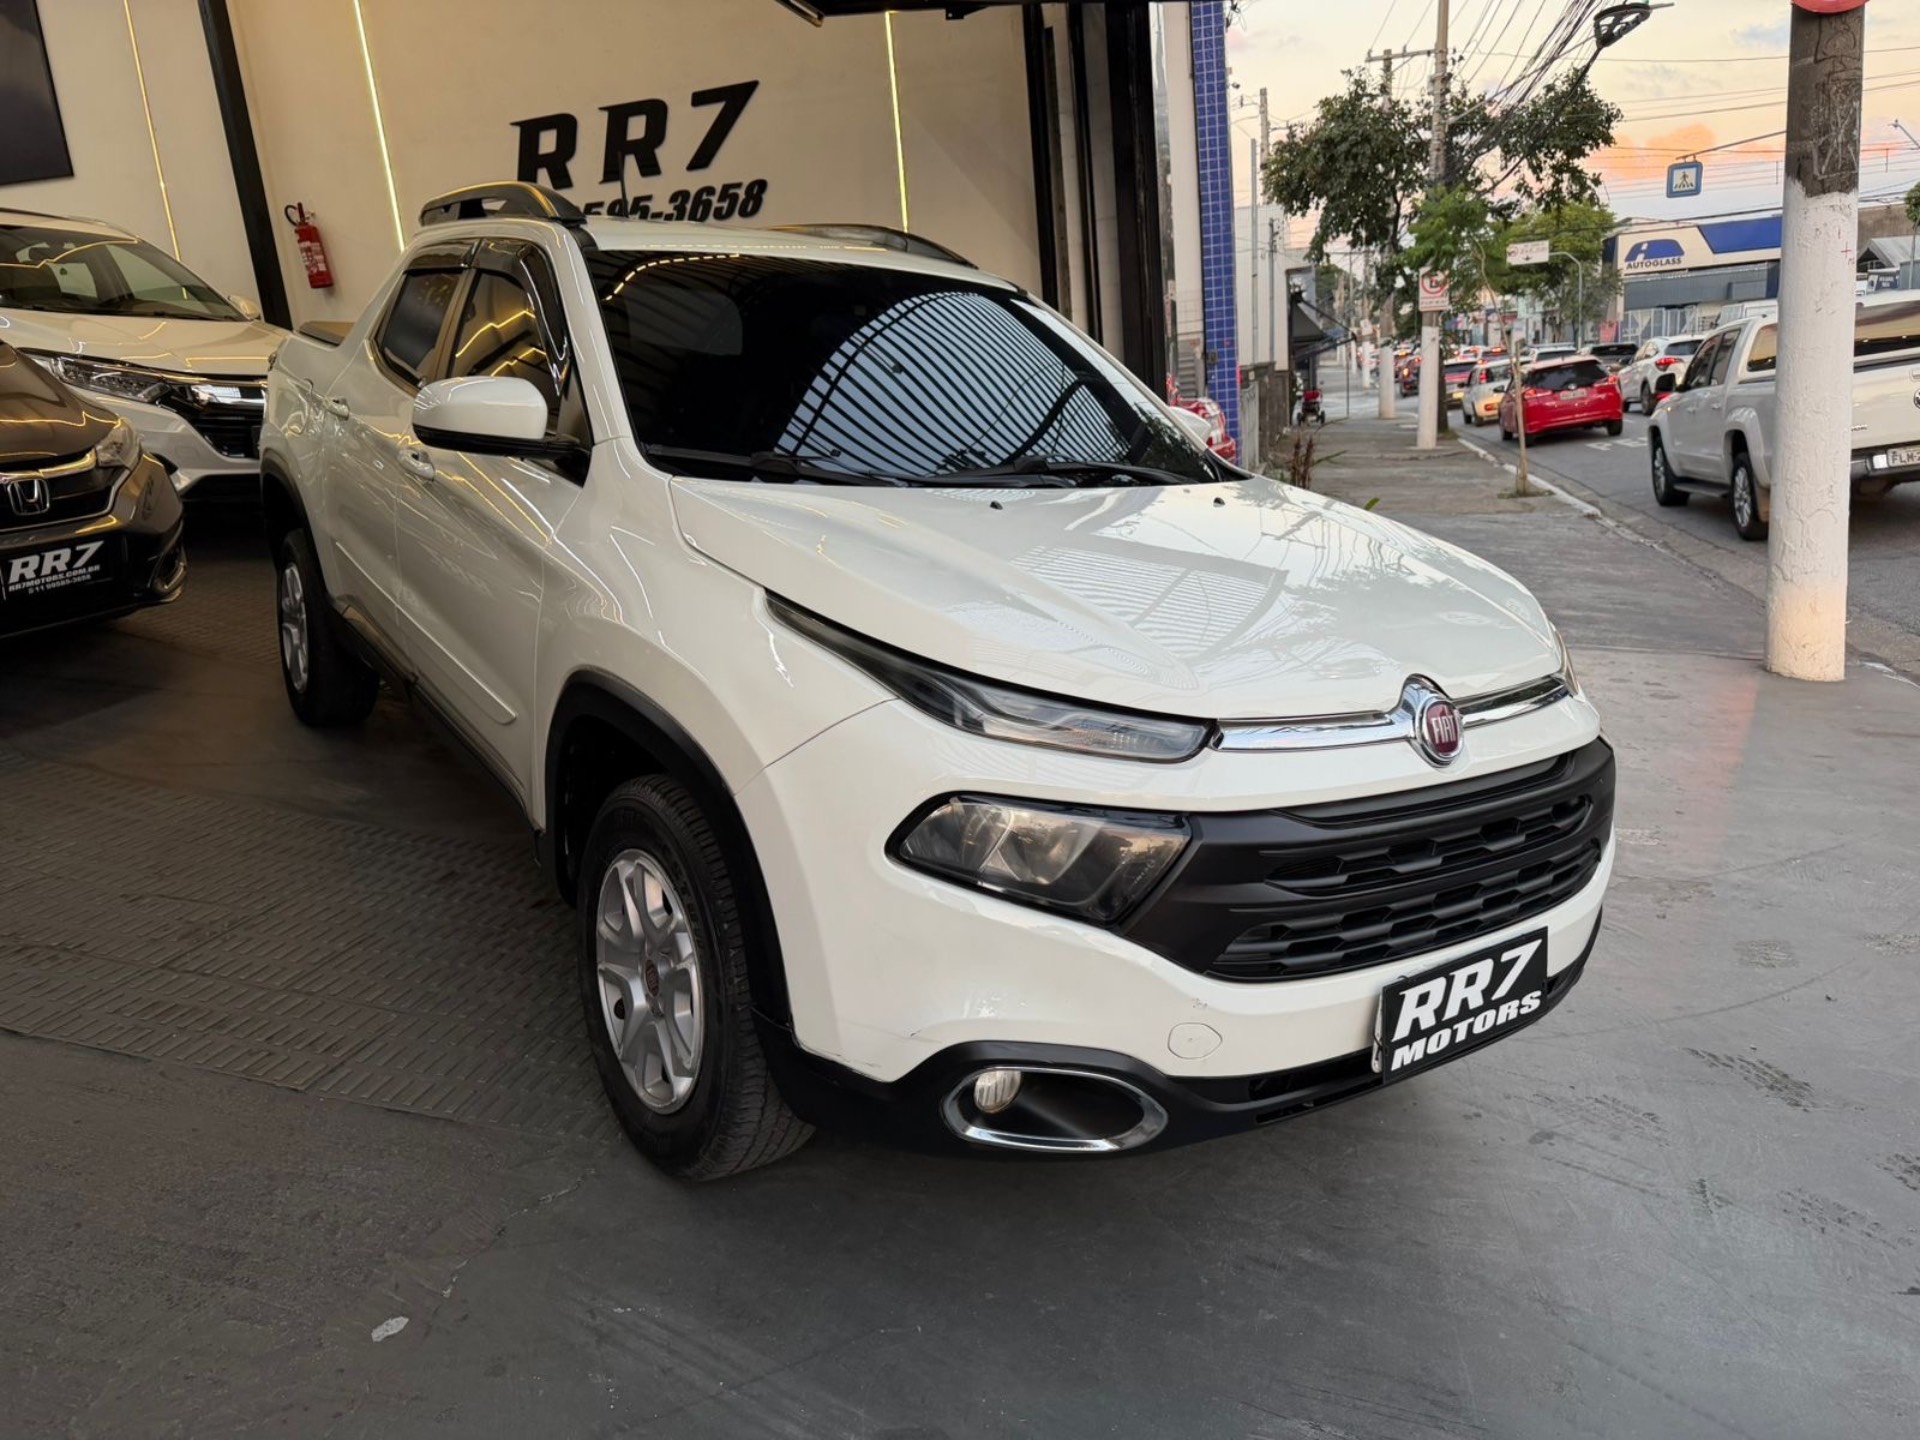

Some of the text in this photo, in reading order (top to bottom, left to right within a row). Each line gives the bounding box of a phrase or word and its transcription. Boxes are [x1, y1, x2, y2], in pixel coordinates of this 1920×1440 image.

[509, 79, 759, 191] RR7
[1626, 257, 1682, 269] AUTOGLASS
[8, 540, 104, 585] RR7
[1430, 714, 1457, 744] FIAT
[1391, 939, 1543, 1042] RR7
[1391, 990, 1542, 1071] MOTORS
